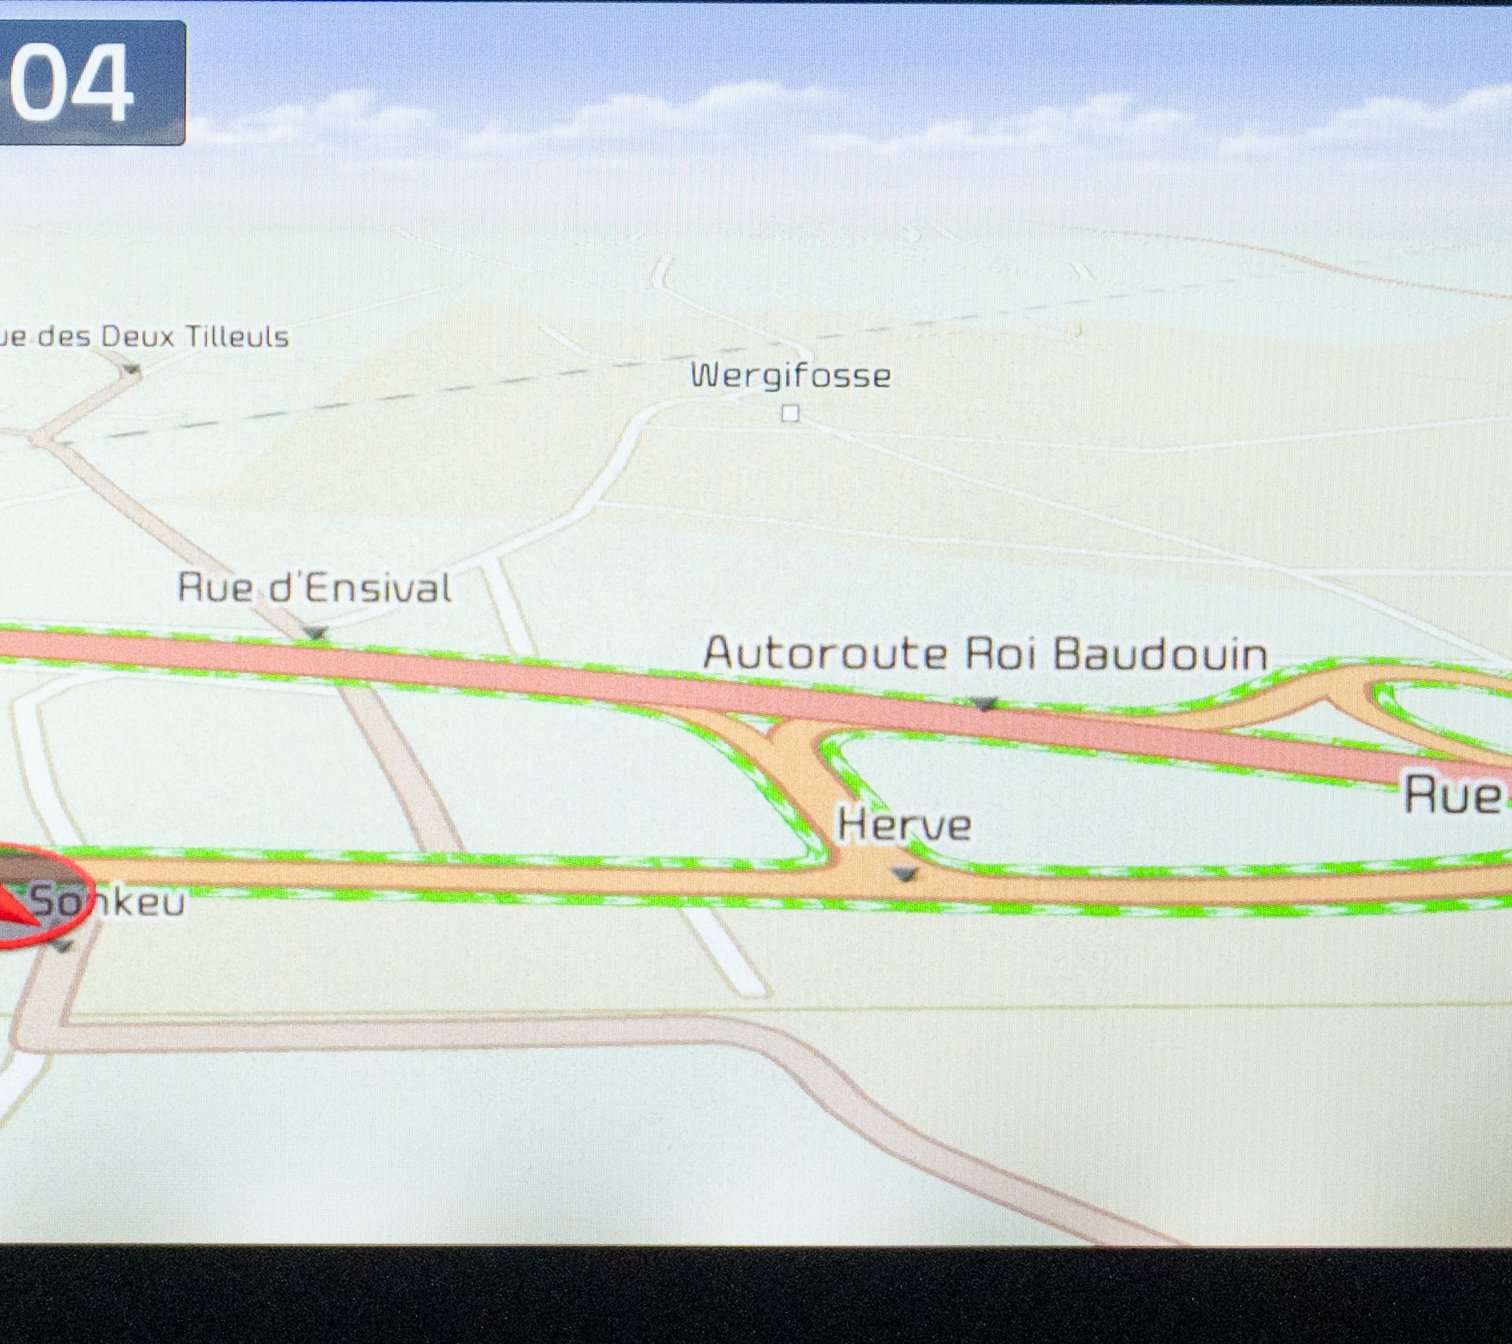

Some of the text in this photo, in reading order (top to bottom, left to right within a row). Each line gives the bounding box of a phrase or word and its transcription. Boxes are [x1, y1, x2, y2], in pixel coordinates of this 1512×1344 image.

[37, 324, 92, 348] des
[101, 323, 175, 348] Deux
[185, 324, 290, 349] Tilleuls
[691, 360, 892, 393] Wergifosse
[178, 570, 452, 604] Rue d'Ensival
[703, 633, 1268, 672] Autoroute Roi Baudouin
[1405, 773, 1502, 815] Rue
[839, 806, 972, 842] Herve
[30, 883, 185, 917] Sonkeu
